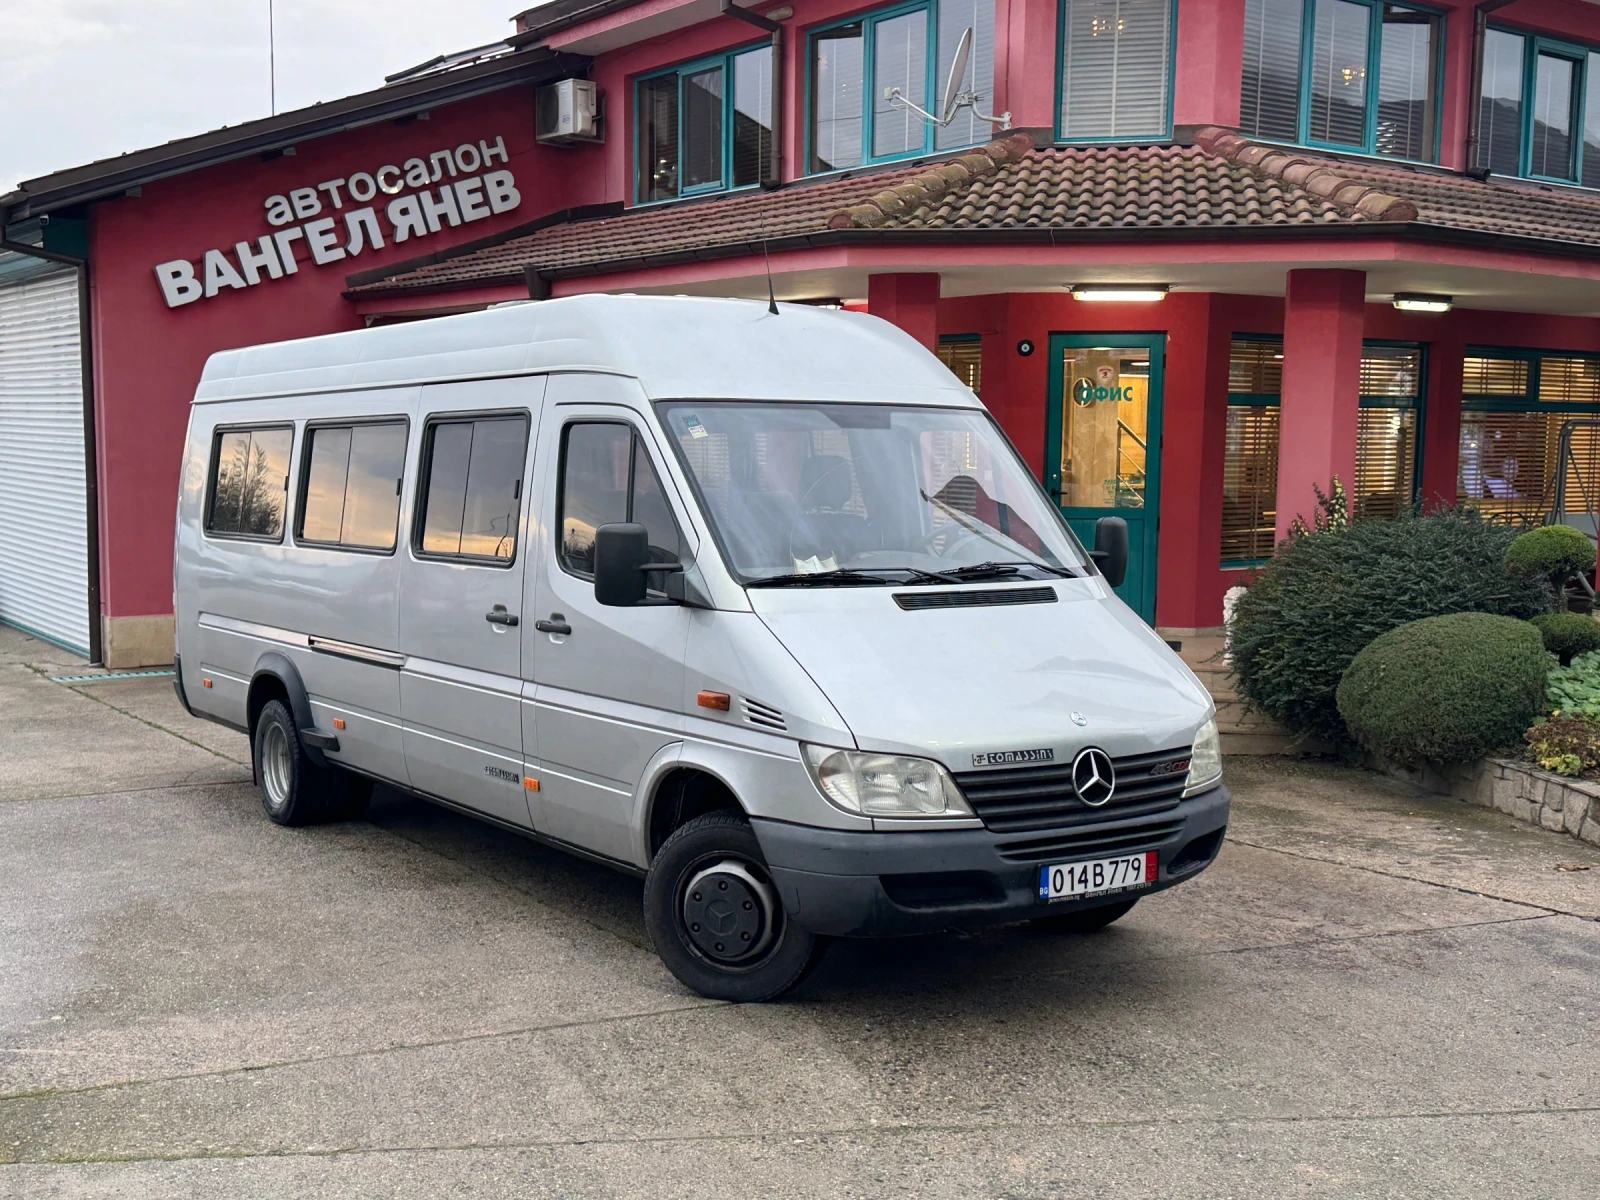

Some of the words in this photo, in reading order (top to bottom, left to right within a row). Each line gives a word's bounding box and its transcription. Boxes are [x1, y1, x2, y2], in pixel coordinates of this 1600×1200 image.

[264, 136, 509, 226] автосалон
[154, 207, 385, 308] ВАНГЕЛ
[385, 169, 521, 243] ЯНЕВ
[1039, 886, 1048, 895] BG
[1052, 858, 1141, 893] 014B779
